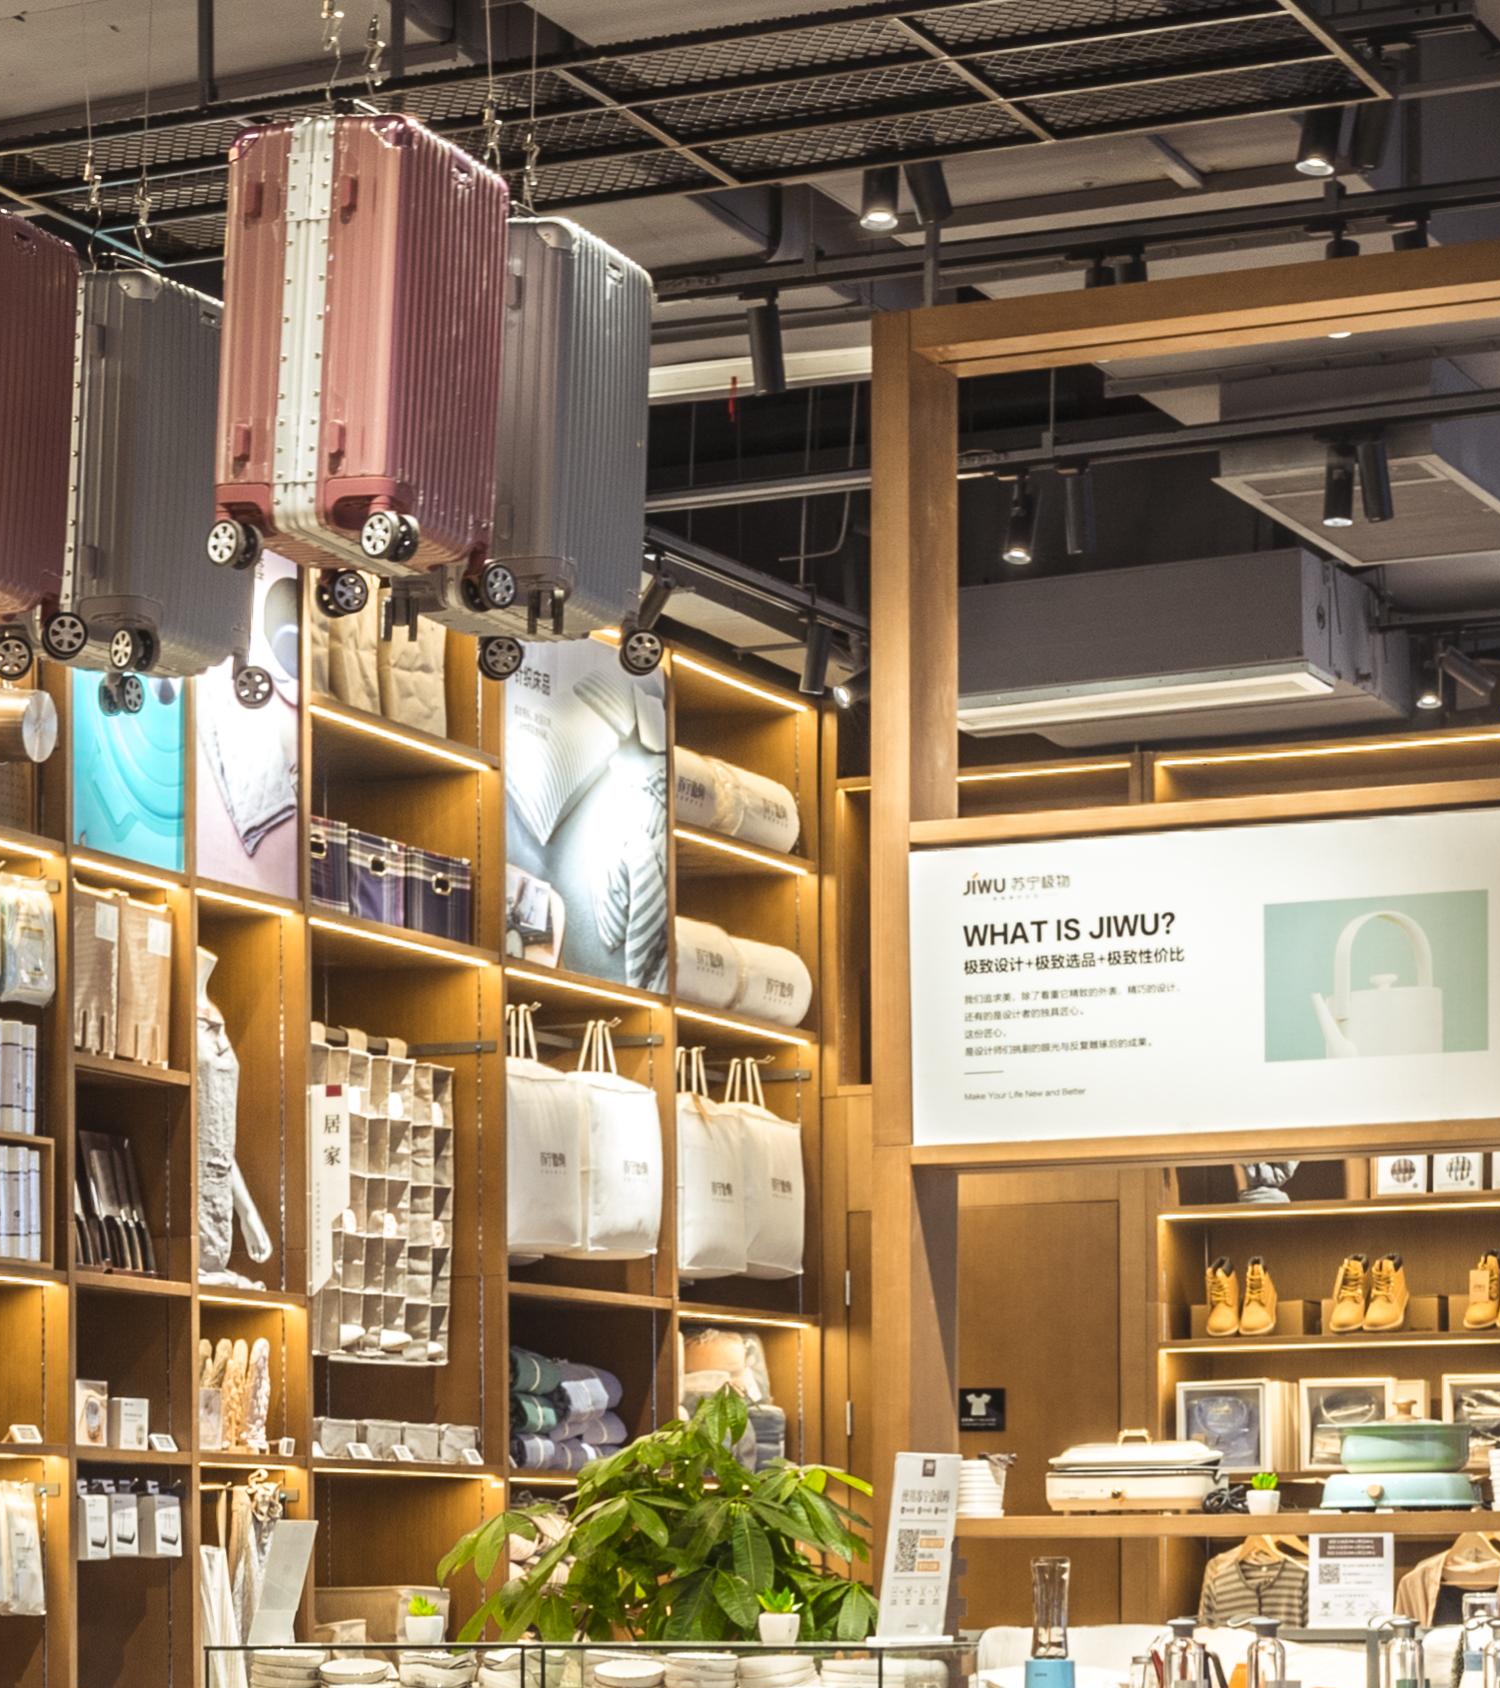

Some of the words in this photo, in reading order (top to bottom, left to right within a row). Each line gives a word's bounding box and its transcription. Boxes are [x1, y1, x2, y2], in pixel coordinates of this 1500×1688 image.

[963, 920, 1048, 947] WHAT
[1056, 918, 1081, 941] IS
[1089, 911, 1176, 940] JIWU?
[964, 946, 1185, 975] 极致设计+极致选品+极致性价比
[964, 1092, 986, 1100] Make
[988, 1091, 1007, 1100] Your
[1009, 1089, 1023, 1099] Life
[1025, 1090, 1043, 1098] New
[1045, 1088, 1060, 1097] and
[1062, 1087, 1086, 1096] Better
[324, 1115, 341, 1166] 居家
